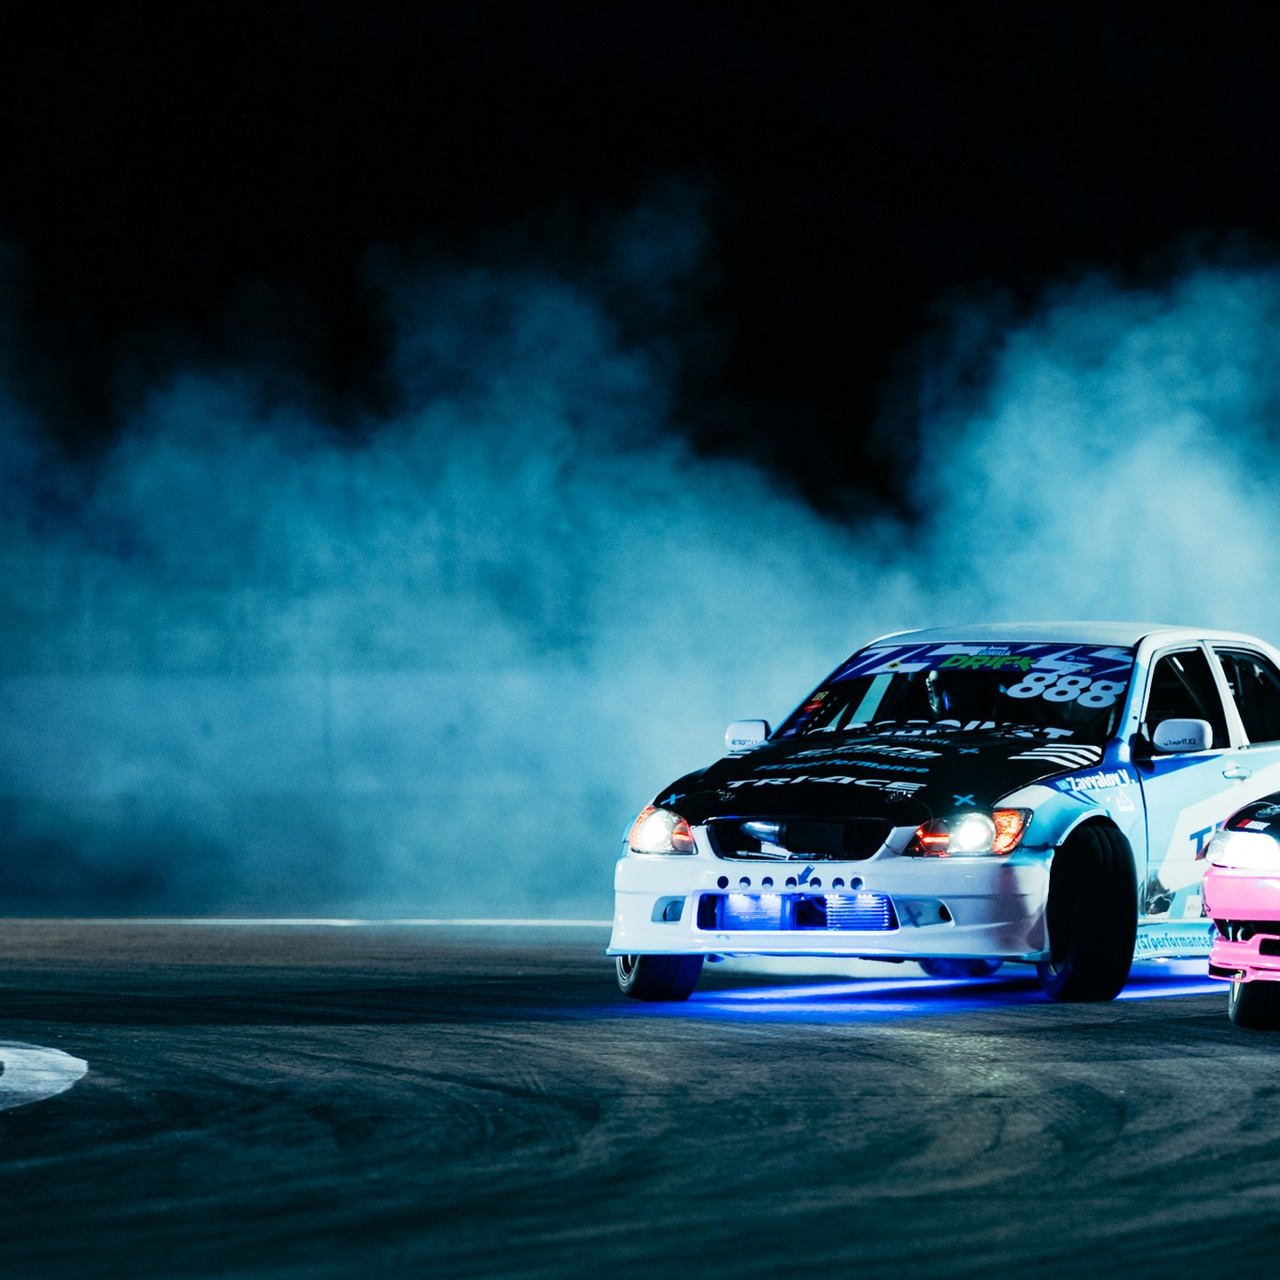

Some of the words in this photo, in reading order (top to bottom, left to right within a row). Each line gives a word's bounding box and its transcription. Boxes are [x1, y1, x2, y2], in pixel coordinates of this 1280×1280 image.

[939, 654, 1038, 671] DRIFT
[1006, 671, 1129, 708] 888
[1067, 770, 1119, 792] Zavyalov
